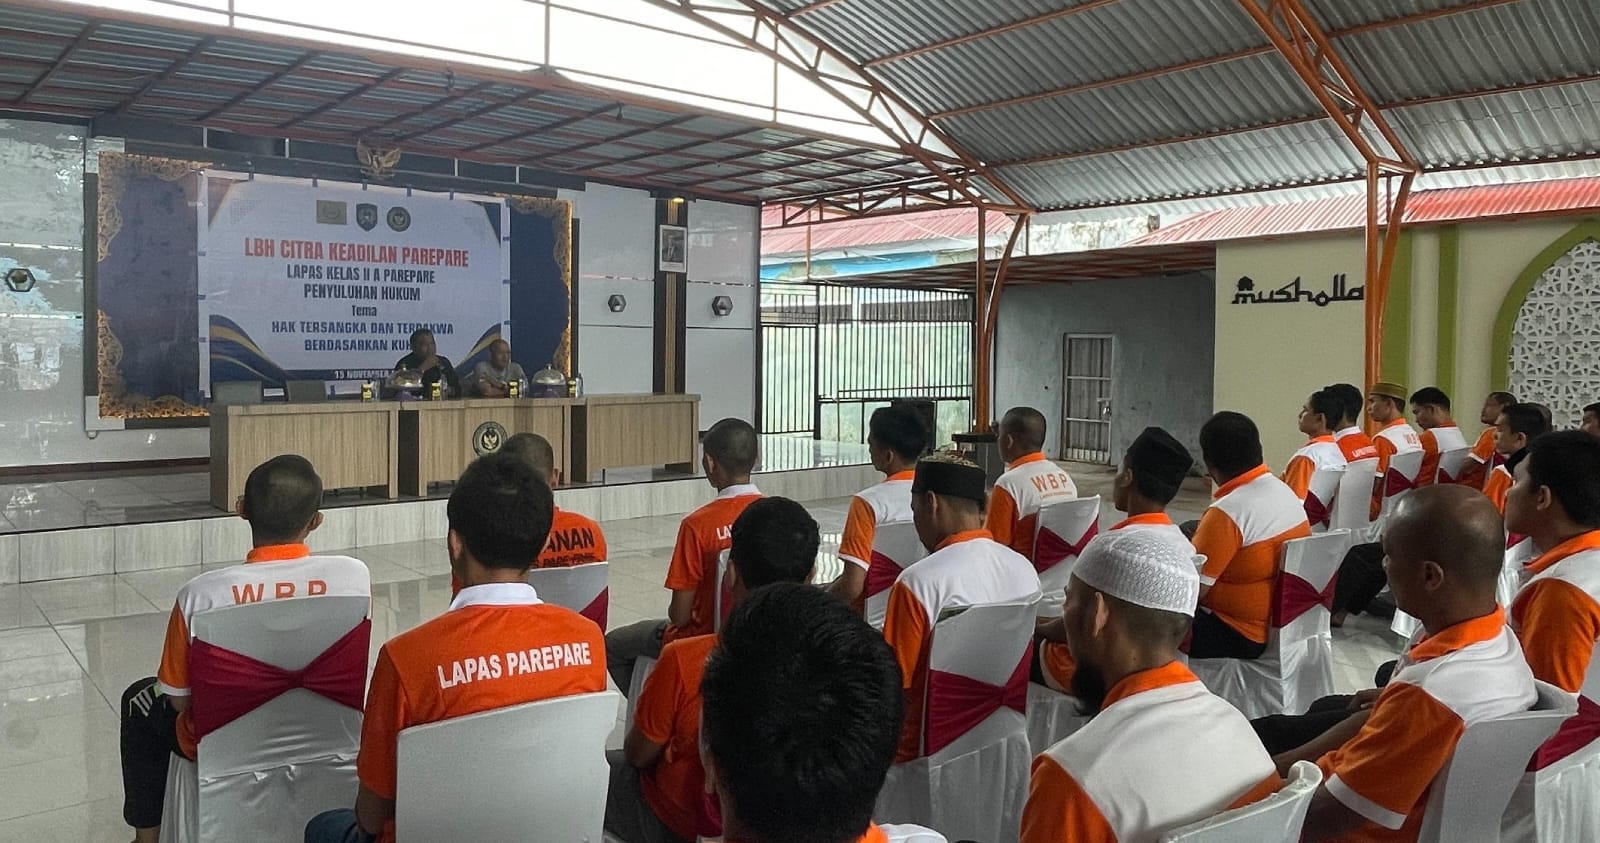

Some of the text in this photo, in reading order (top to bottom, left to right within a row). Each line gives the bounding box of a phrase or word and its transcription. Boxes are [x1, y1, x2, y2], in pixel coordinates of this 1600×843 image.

[244, 237, 469, 267] LBH CITRA KEADILAN PAREPARE
[287, 264, 323, 279] LAPAS
[326, 266, 360, 280] KELAS
[373, 268, 380, 281] A
[383, 269, 435, 283] PAREPARE
[304, 283, 420, 300] PENYULUHAN HUKUM
[352, 305, 377, 316] Tema
[272, 321, 296, 333] HAK
[300, 321, 367, 334] TERSANGKA
[371, 322, 394, 334] DAN
[304, 339, 412, 351] BERDASARKAN KUH
[544, 527, 595, 552] ANAN
[438, 642, 592, 689] LAPAS PAREPARE
